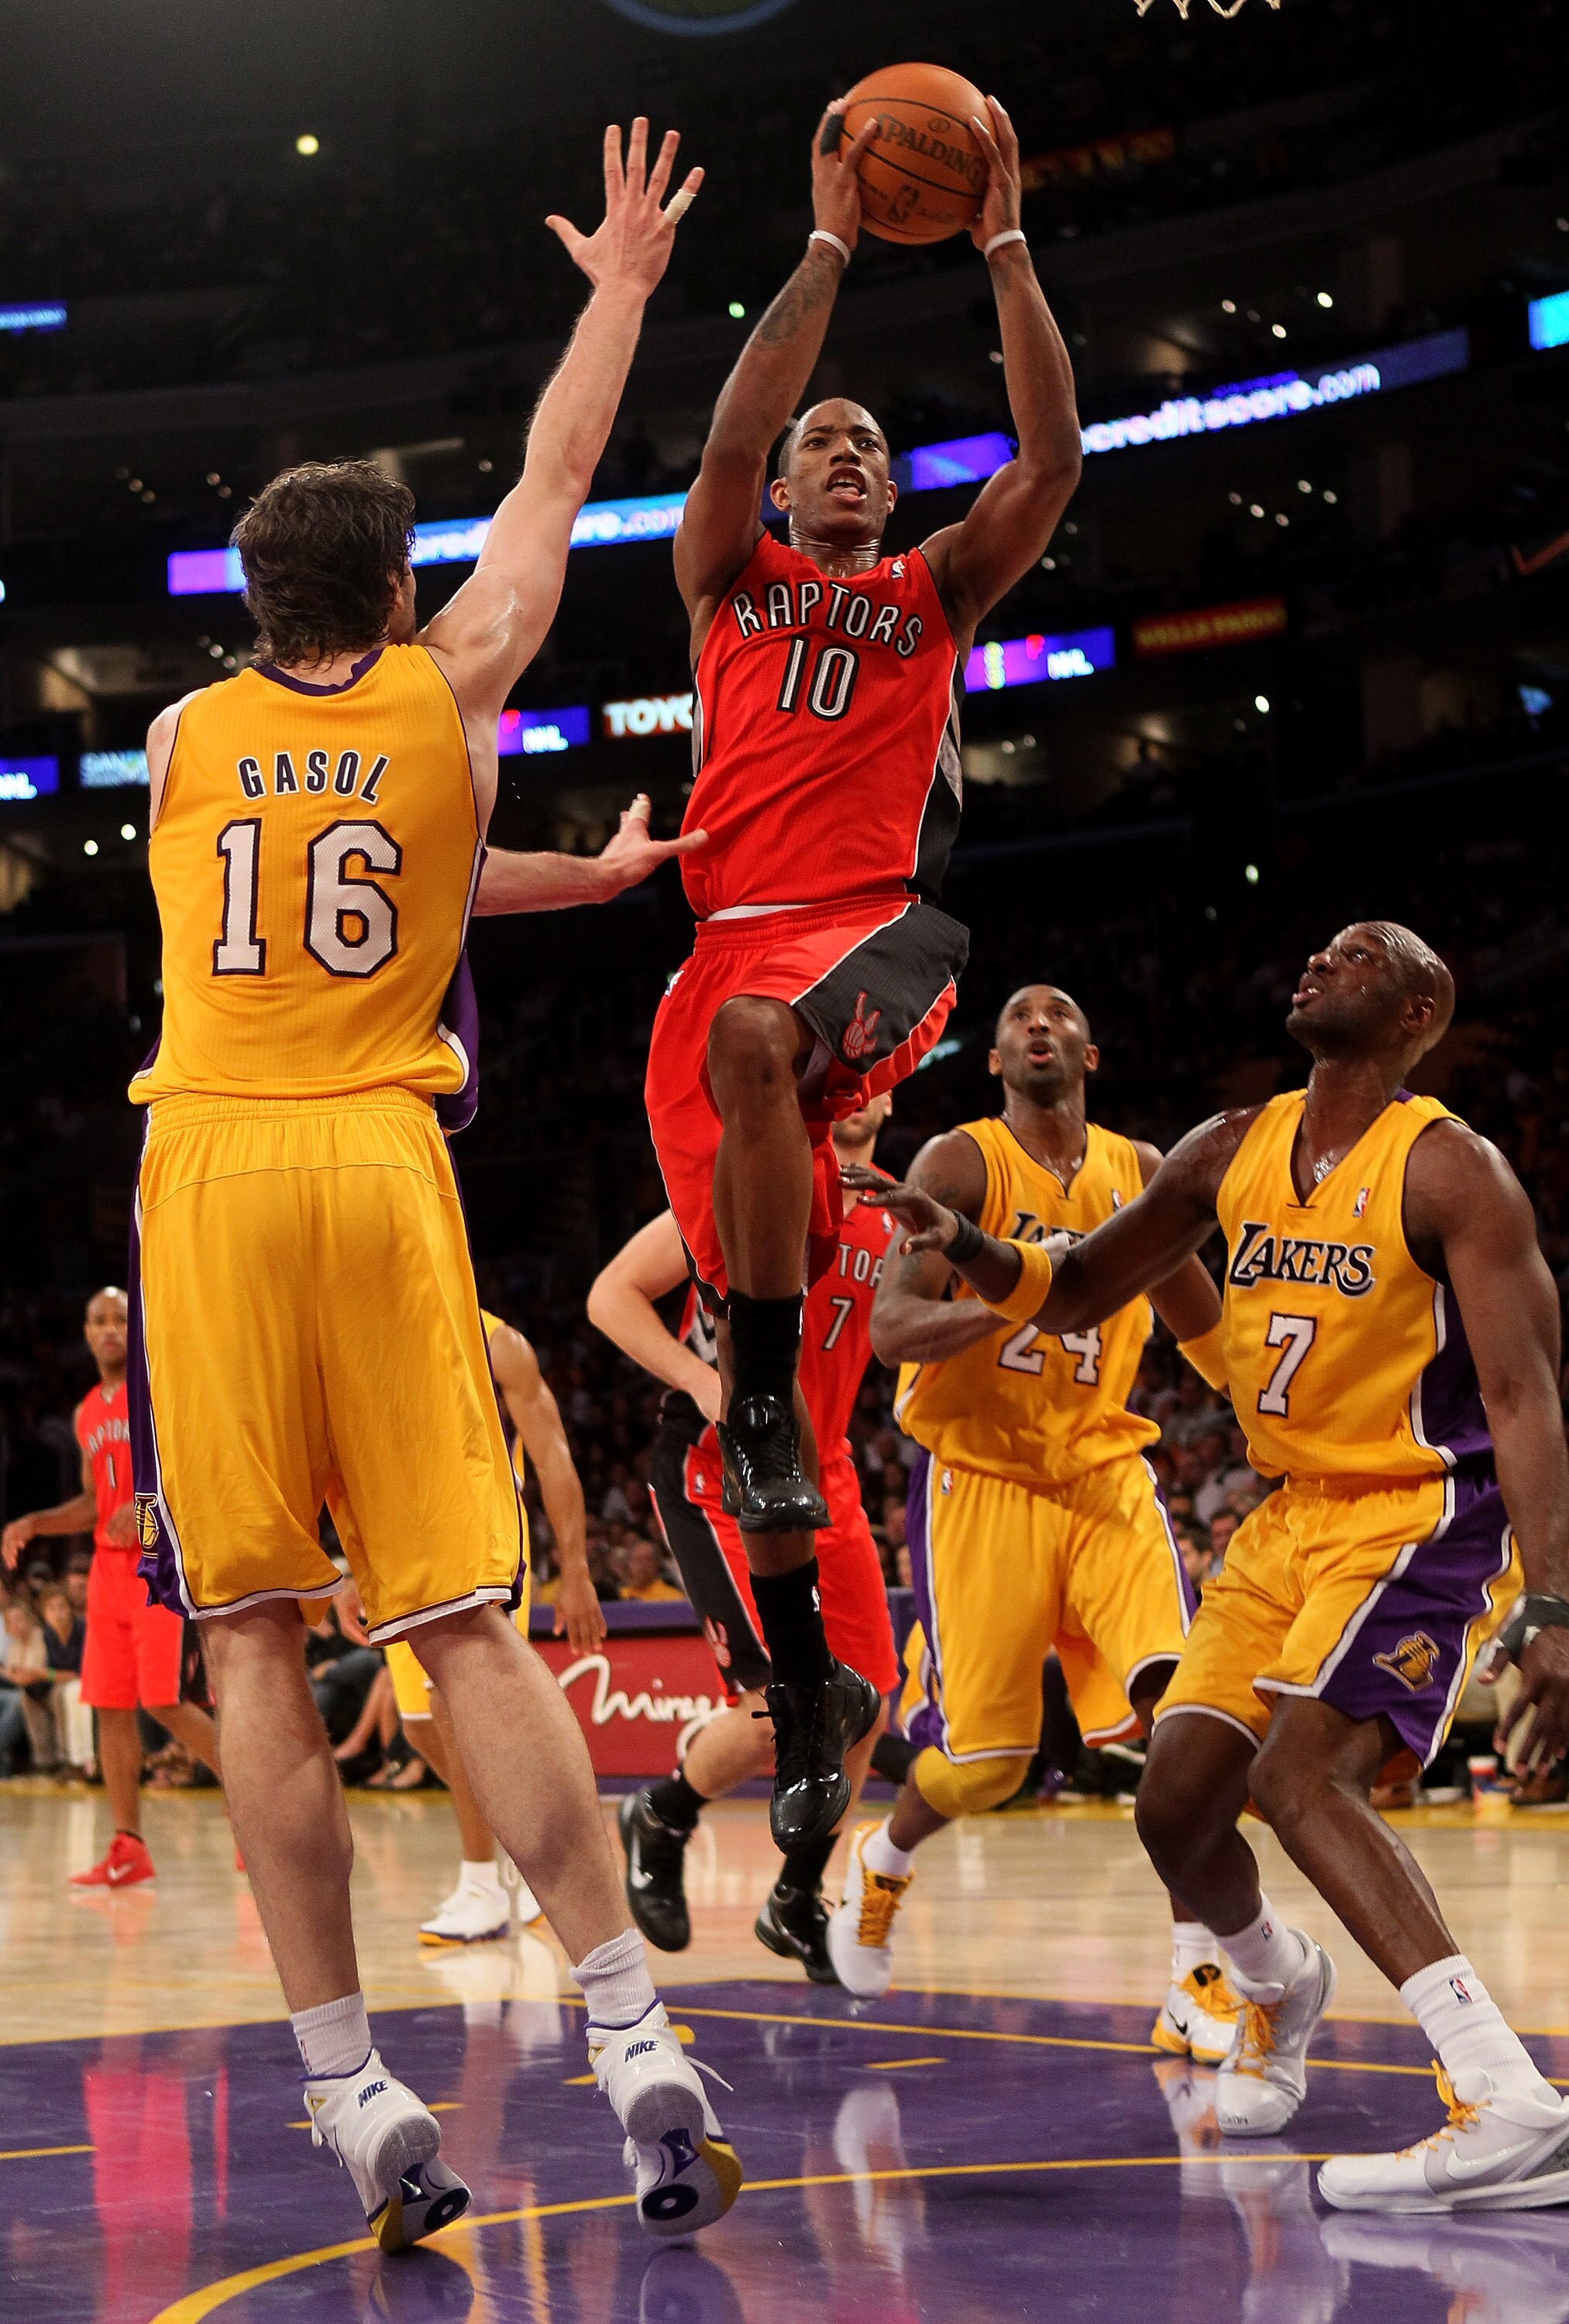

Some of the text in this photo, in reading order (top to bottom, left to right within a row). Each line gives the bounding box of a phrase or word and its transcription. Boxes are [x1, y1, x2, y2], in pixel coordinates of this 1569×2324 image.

[1082, 363, 1381, 456] creditscore.com
[731, 579, 924, 658] RAPTORS
[776, 634, 860, 722] 10
[236, 748, 391, 806] GASOL
[212, 817, 403, 978] 16
[1228, 1220, 1377, 1298] LAKERS
[821, 1295, 855, 1351] 7
[1257, 1311, 1317, 1418] 7
[106, 1452, 117, 1490] 1
[625, 2040, 659, 2064] NIKE
[357, 2079, 388, 2109] NIKE
